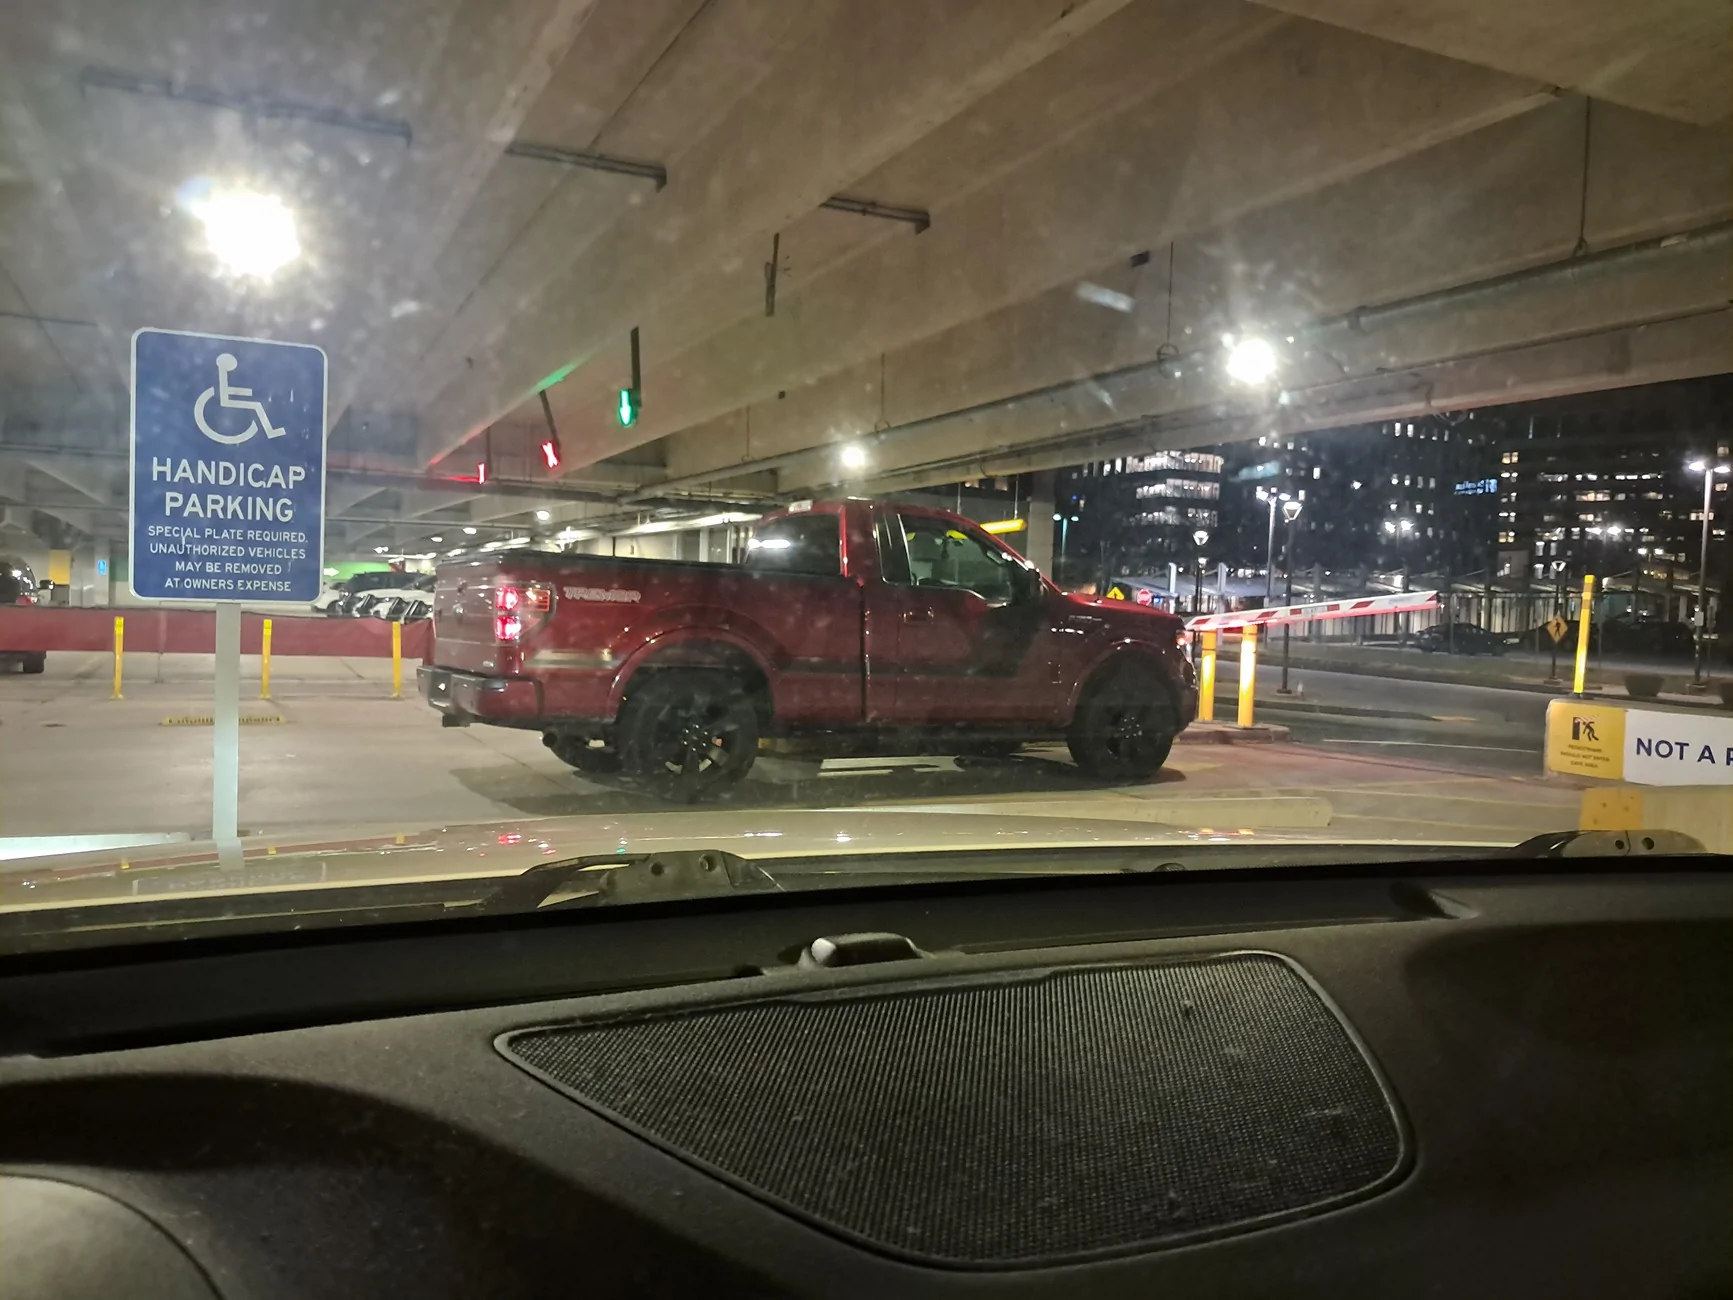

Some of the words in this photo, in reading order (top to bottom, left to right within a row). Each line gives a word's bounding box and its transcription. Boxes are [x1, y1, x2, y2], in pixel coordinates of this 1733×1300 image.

[152, 456, 306, 489] HANDICAP
[165, 491, 293, 522] PARKING
[148, 525, 201, 539] SPECIAL
[204, 528, 244, 540] PLATE
[247, 530, 308, 543] REQUIRED.
[149, 543, 245, 557] UNAUTHORIZED
[248, 547, 306, 559] VEHICLES
[175, 561, 202, 572] MAY
[205, 562, 222, 573] BE
[225, 563, 282, 575] REMOVED
[164, 578, 180, 589] AT
[183, 578, 234, 590] OWNERS
[237, 579, 292, 592] EXPENSE
[1635, 737, 1690, 761] NOT
[1697, 744, 1716, 765] A
